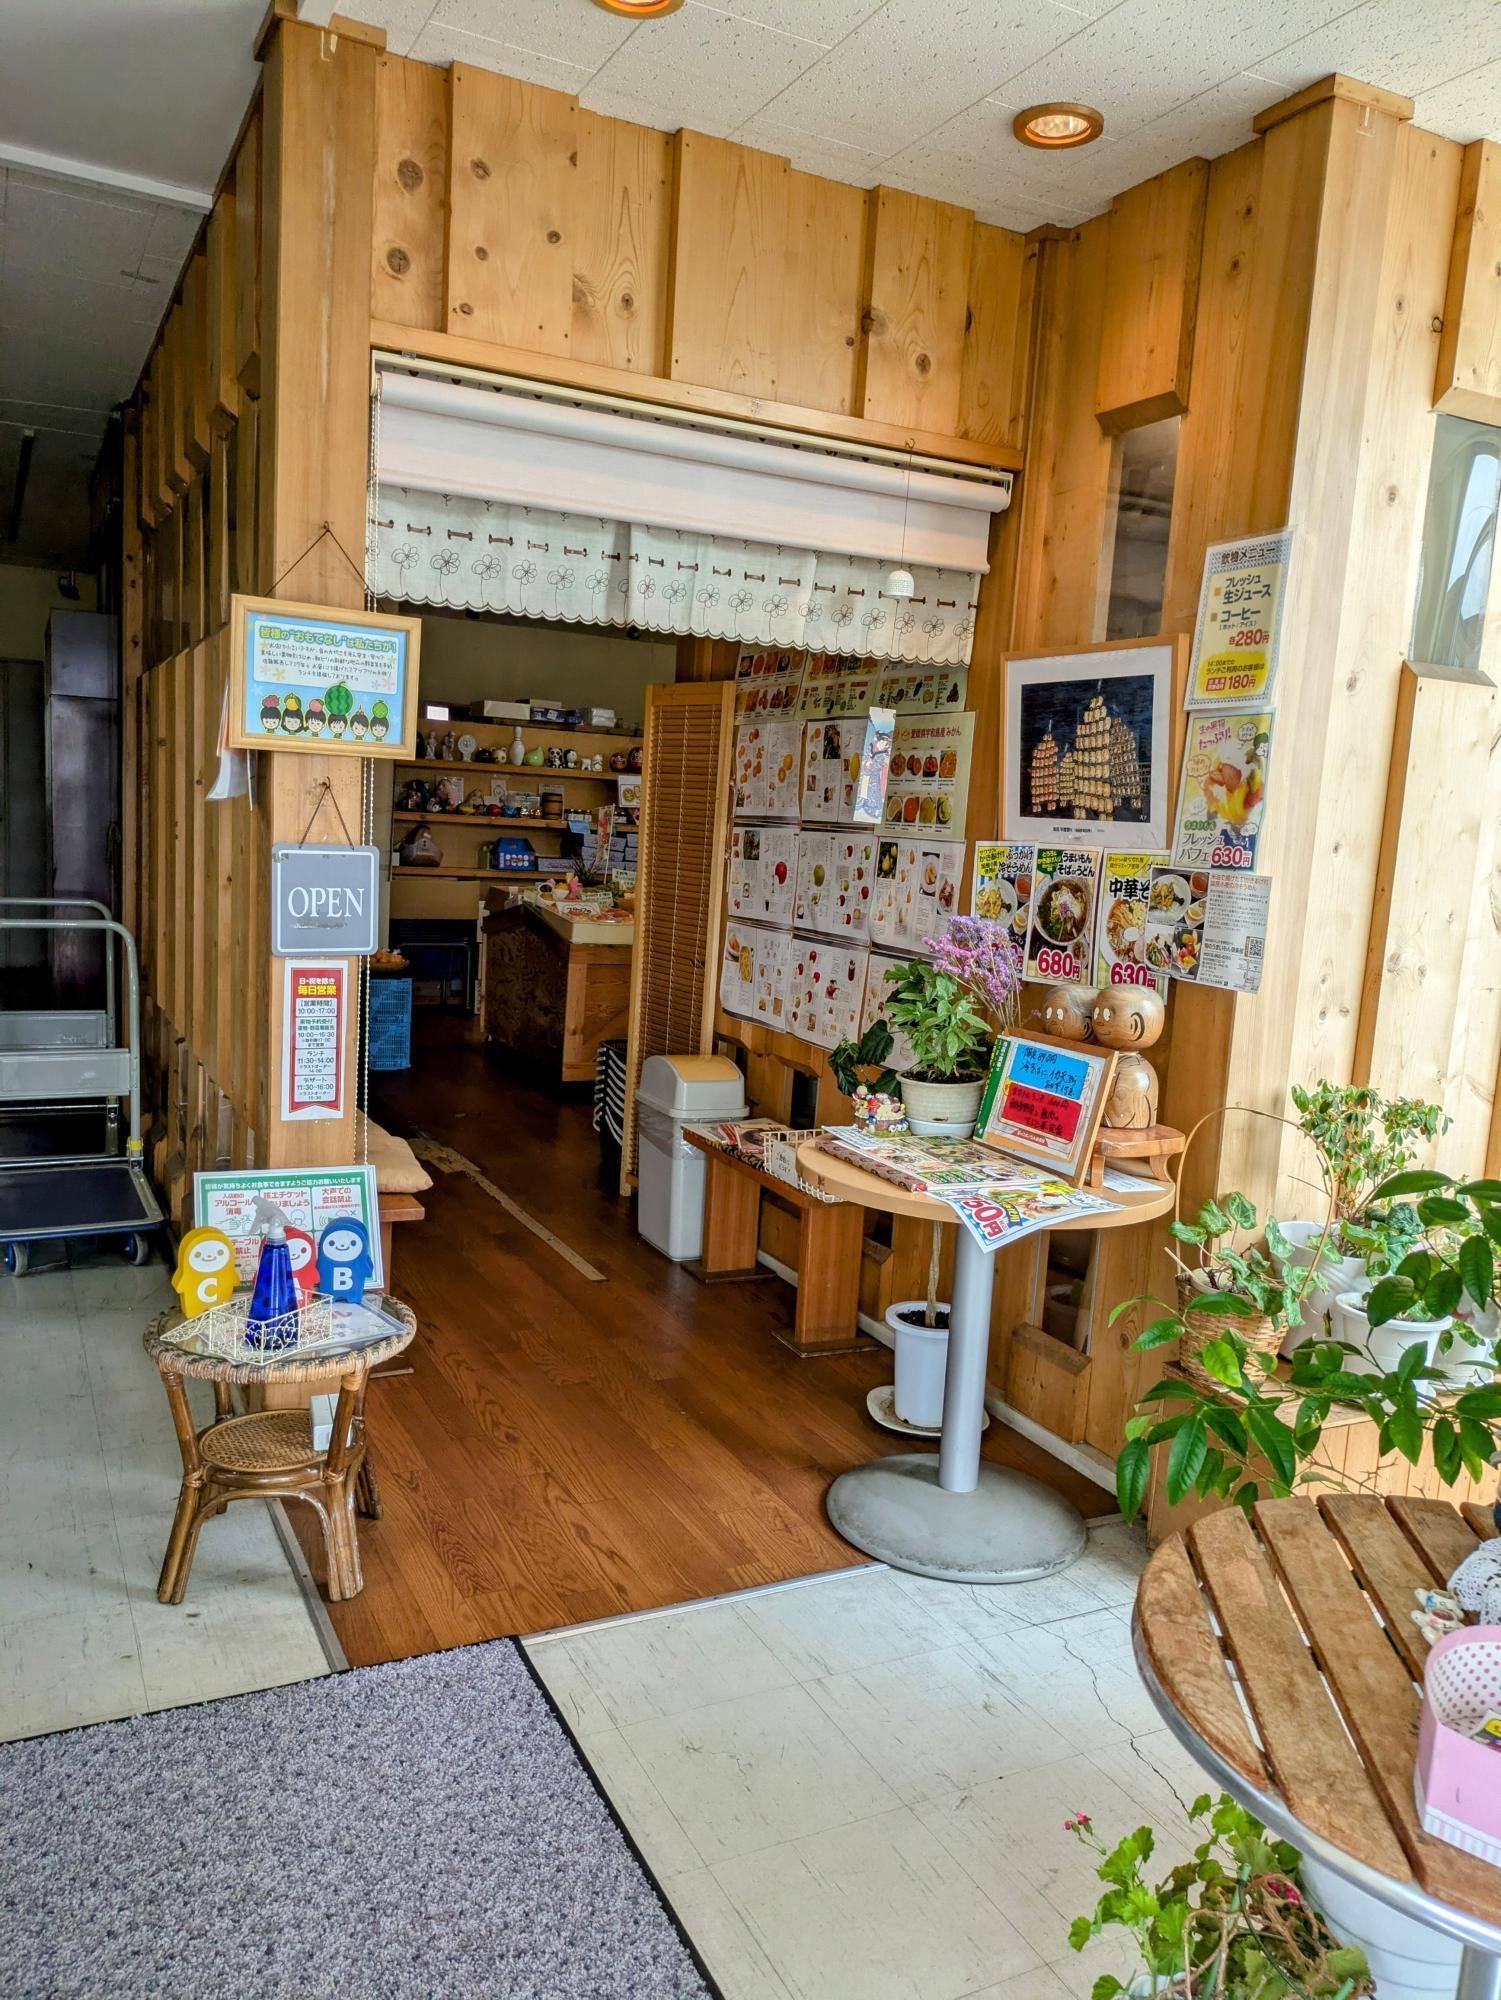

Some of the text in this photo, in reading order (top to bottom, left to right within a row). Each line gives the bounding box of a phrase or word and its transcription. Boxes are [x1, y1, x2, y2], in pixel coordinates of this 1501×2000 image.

[1225, 574, 1261, 589] フレッシュ
[1223, 584, 1271, 605] 生ジュース
[1221, 608, 1261, 623] コーヒー
[1182, 833, 1224, 846] フレッシュ
[1006, 848, 1034, 861] ぶっかけ
[1062, 852, 1093, 864] うまいもん
[1179, 847, 1210, 863] パフェ
[1211, 846, 1251, 866] 630円
[998, 860, 1033, 874] 冷そうめん
[287, 886, 365, 918] OPEN
[1038, 949, 1081, 979] 680円
[1111, 962, 1158, 990] 630円
[297, 985, 337, 996] 毎日営業
[322, 1187, 352, 1196] 大声での
[333, 1267, 354, 1291] B
[197, 1278, 218, 1303] C
